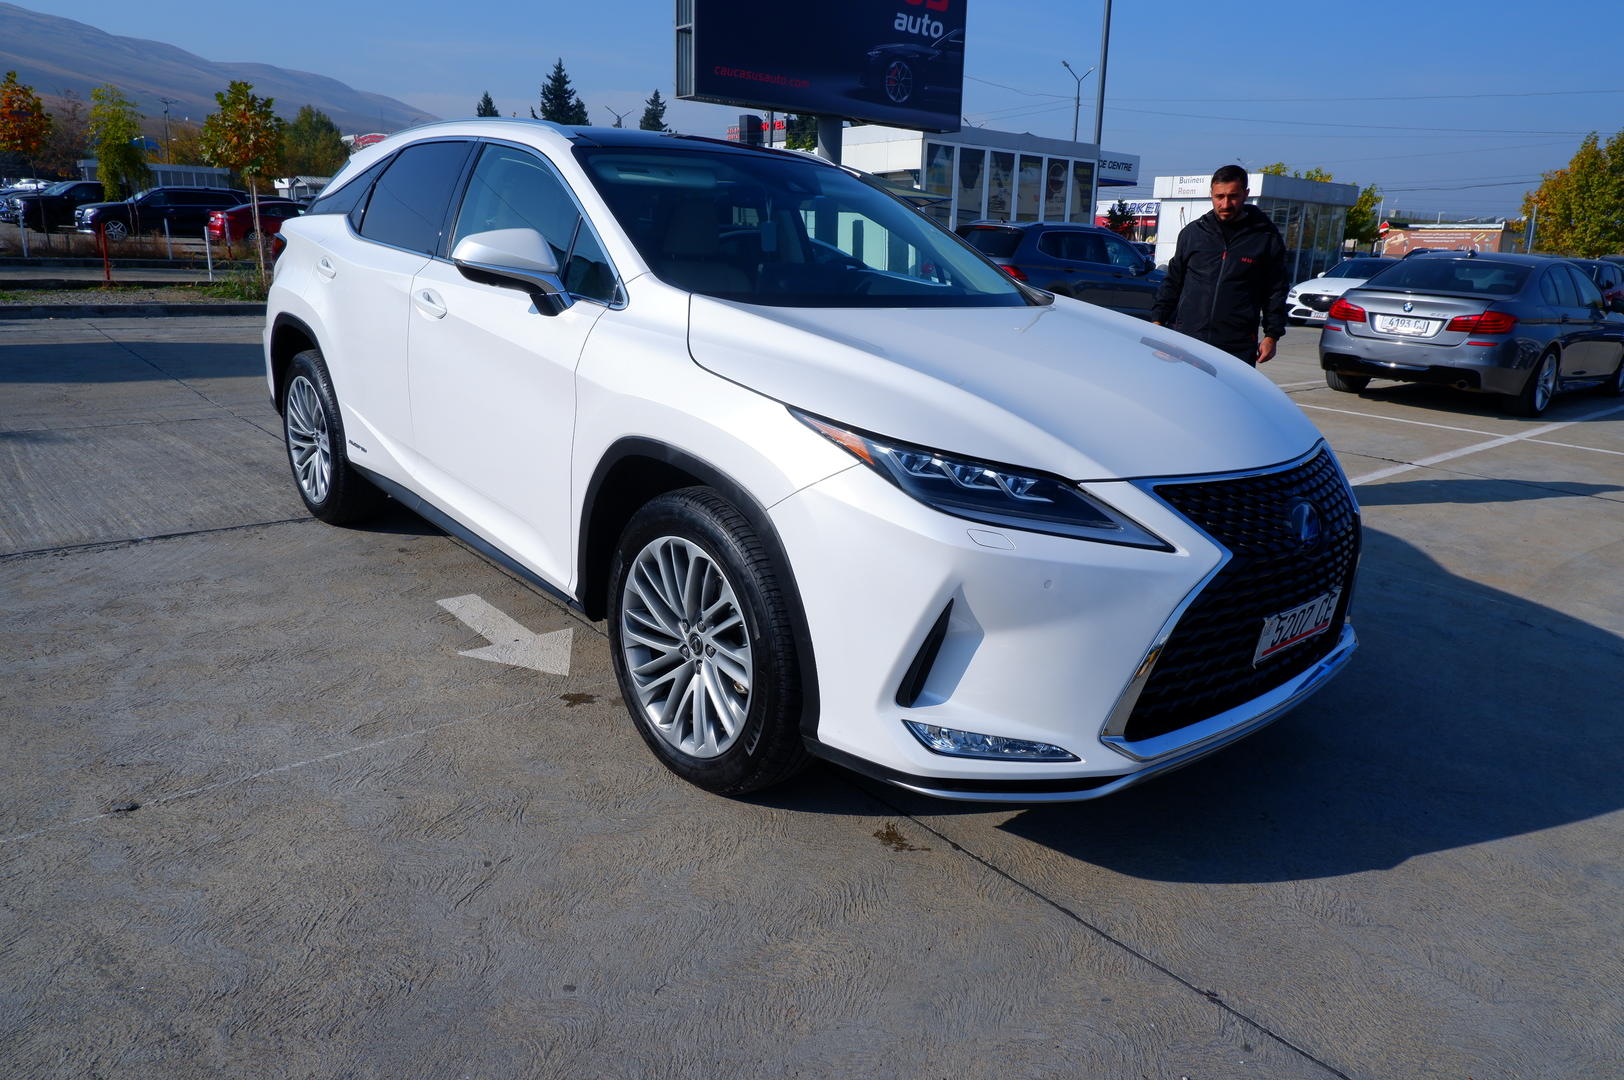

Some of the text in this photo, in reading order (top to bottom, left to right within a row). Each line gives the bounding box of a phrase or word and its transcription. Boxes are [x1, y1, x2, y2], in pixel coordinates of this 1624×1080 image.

[894, 12, 943, 38] auto
[714, 66, 810, 87] caucasusauto.com
[760, 120, 786, 131] HOEL
[1108, 161, 1133, 171] CENTRE
[1271, 604, 1316, 646] 5207
